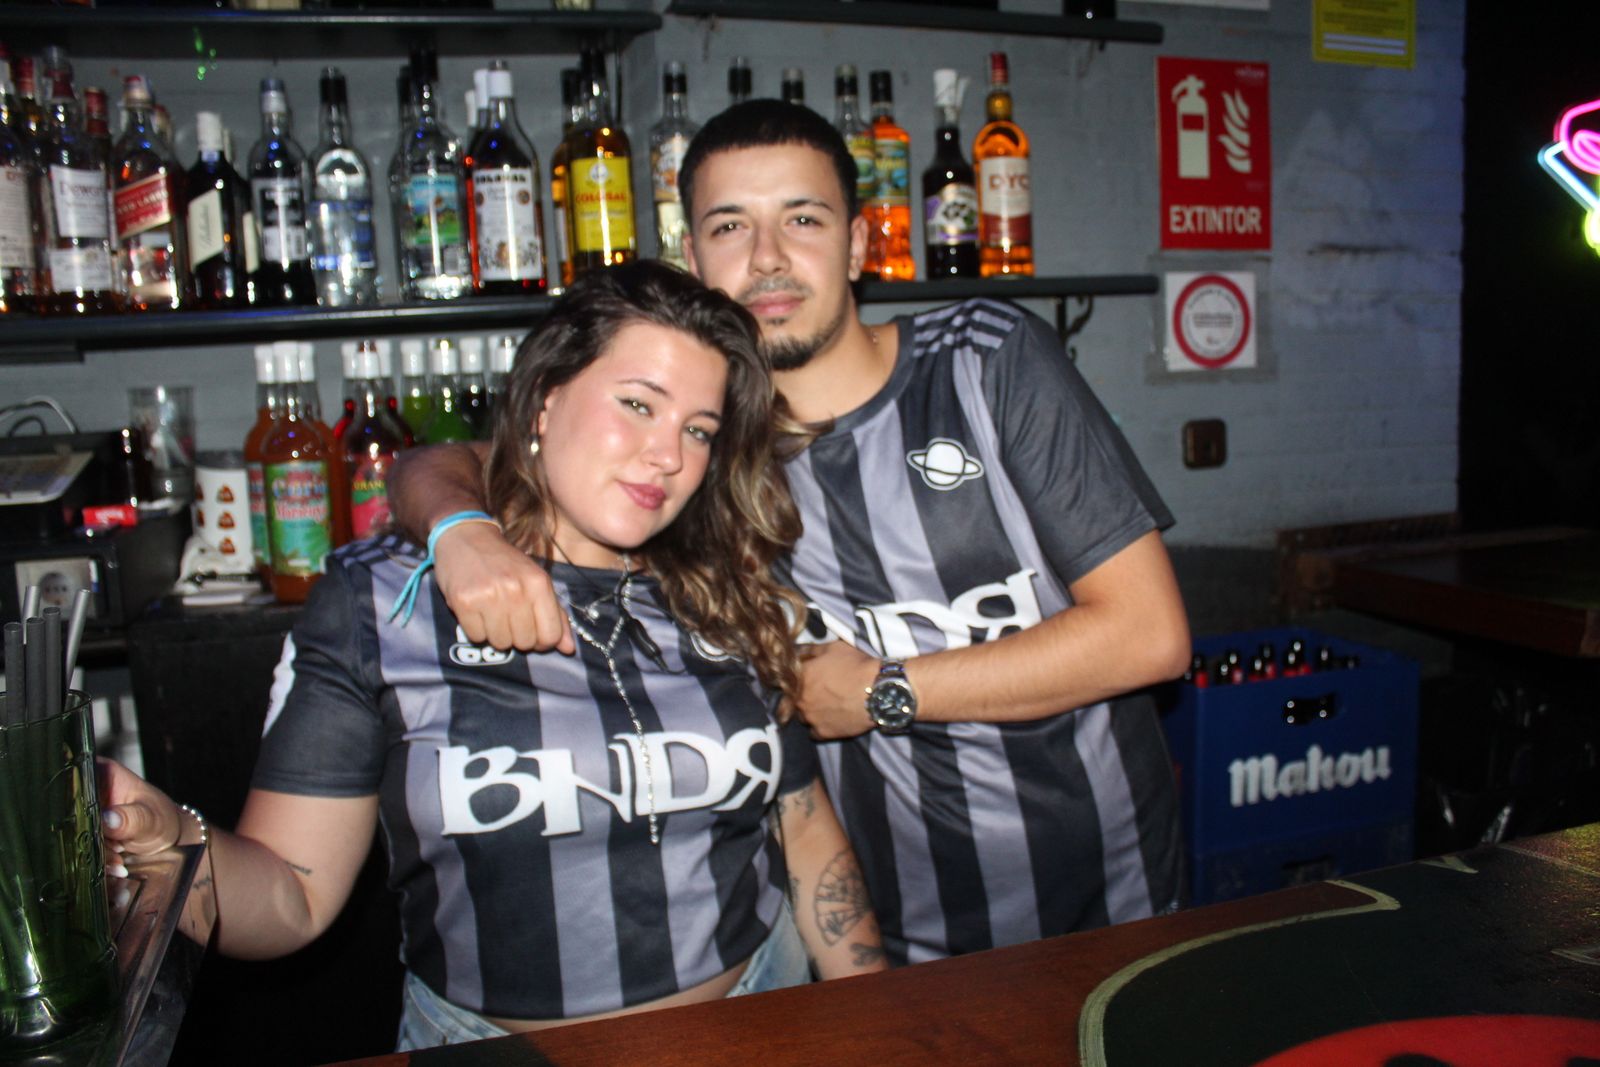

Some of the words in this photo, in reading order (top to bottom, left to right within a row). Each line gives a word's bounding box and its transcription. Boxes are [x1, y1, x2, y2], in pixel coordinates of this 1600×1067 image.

[988, 173, 1032, 191] DYC
[1169, 205, 1262, 234] EXTINTOR
[1228, 744, 1392, 807] Mahou
